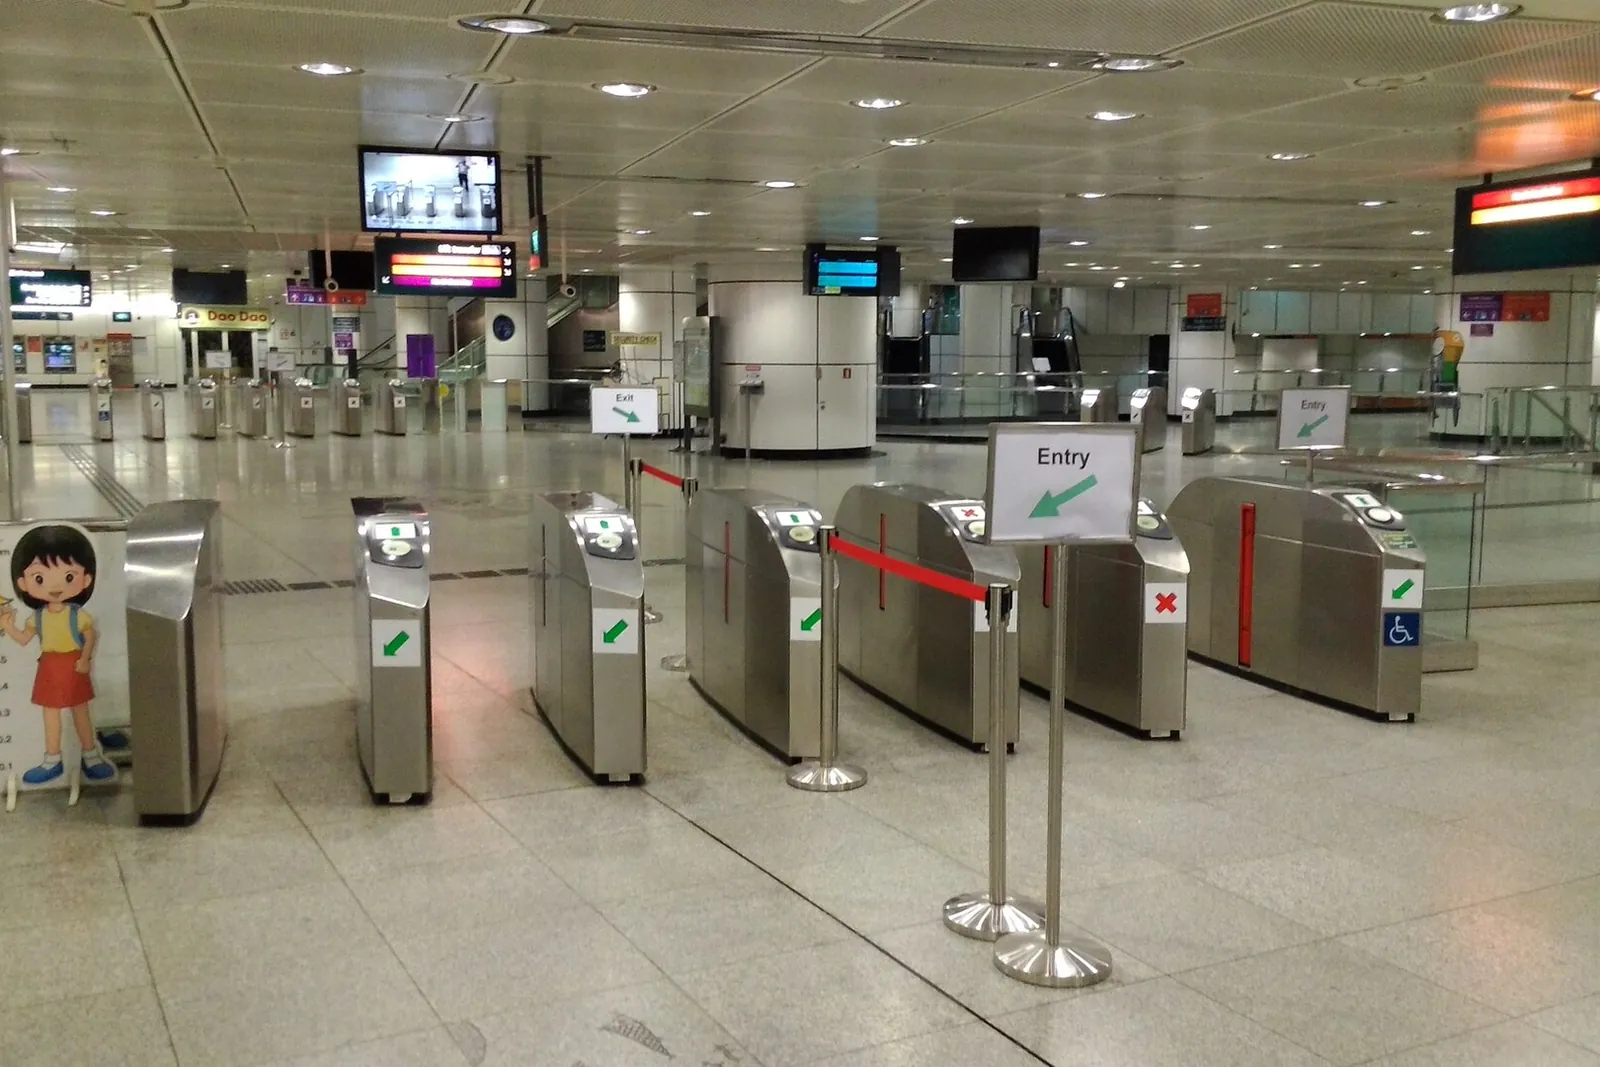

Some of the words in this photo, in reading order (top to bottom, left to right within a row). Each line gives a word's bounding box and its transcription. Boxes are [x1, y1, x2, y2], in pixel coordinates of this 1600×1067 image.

[208, 310, 236, 321] Dao
[240, 311, 267, 322] Dao
[616, 393, 634, 402] Exit
[1300, 399, 1328, 411] Entry
[1037, 447, 1091, 470] Entry
